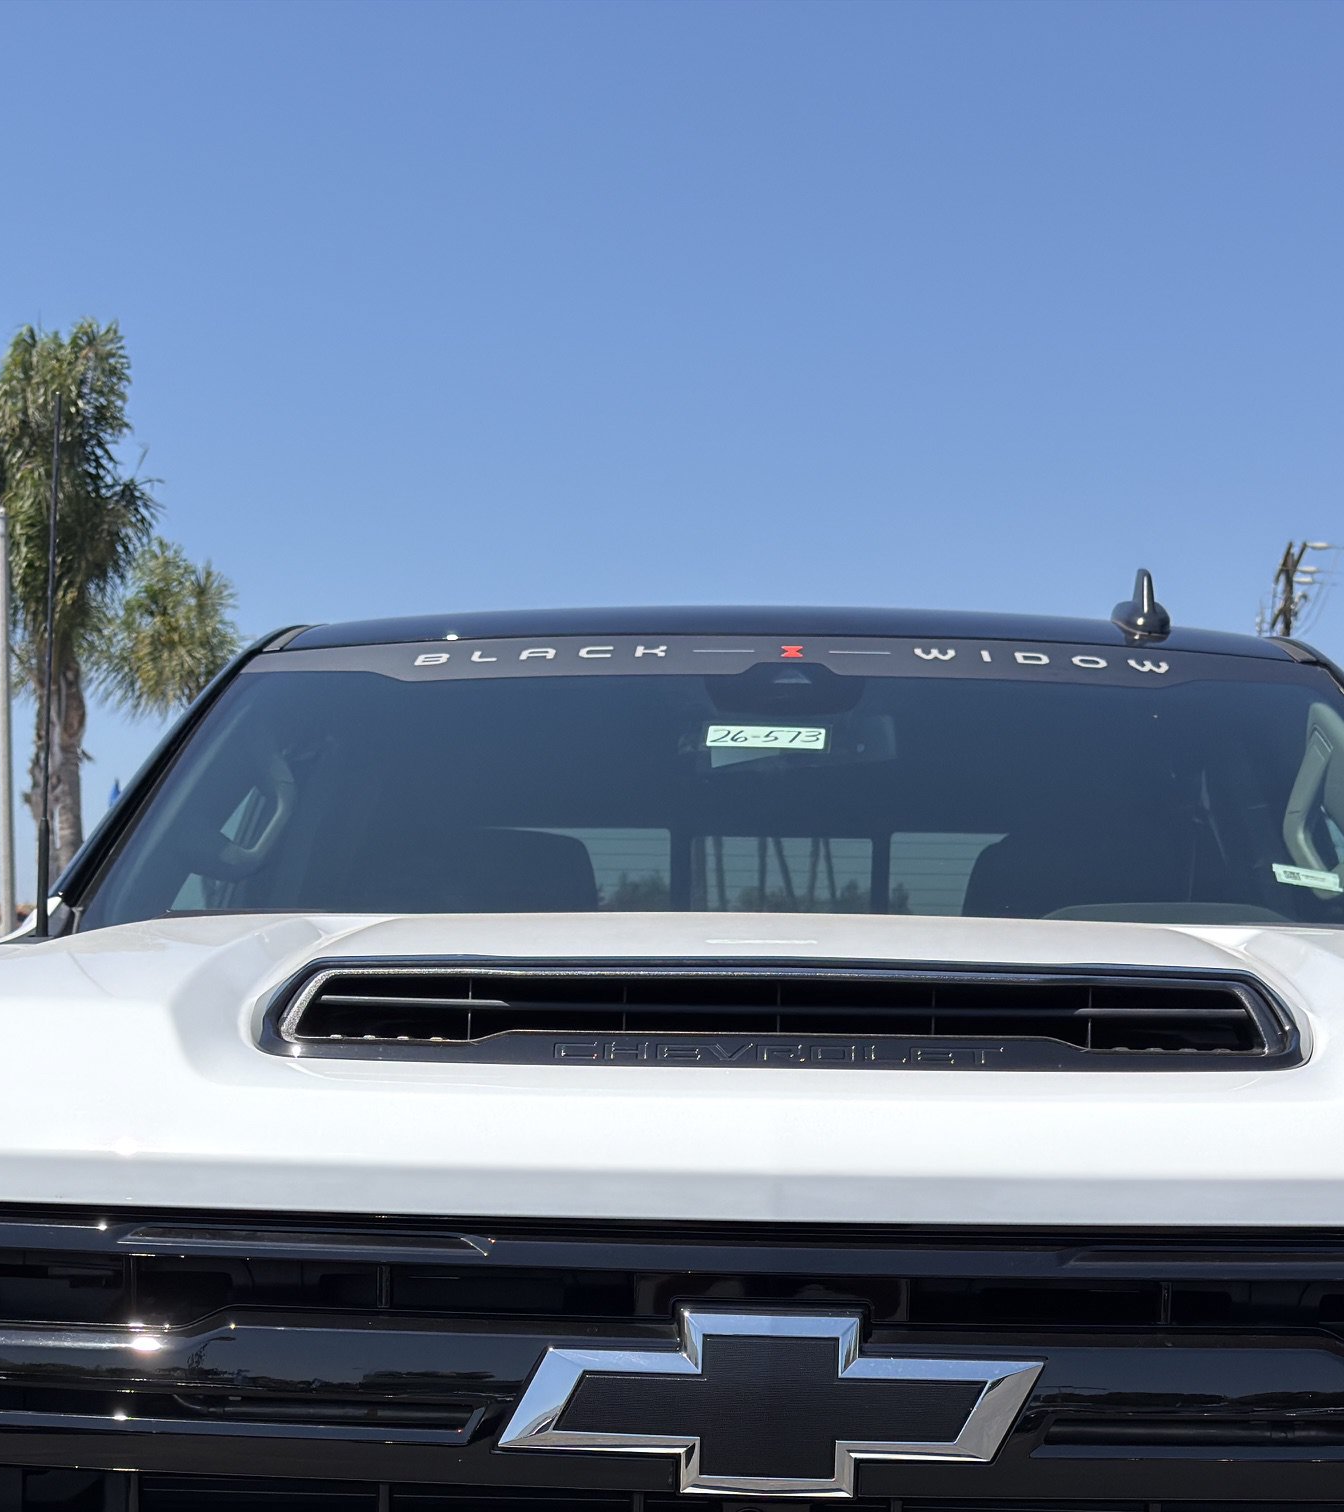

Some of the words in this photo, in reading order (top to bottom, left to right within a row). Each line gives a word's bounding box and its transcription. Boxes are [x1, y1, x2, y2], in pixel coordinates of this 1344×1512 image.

[413, 645, 668, 667] BLACK
[913, 647, 1170, 674] WIDOW
[708, 728, 823, 744] 26-573
[552, 1041, 1004, 1066] CHEVROLET
